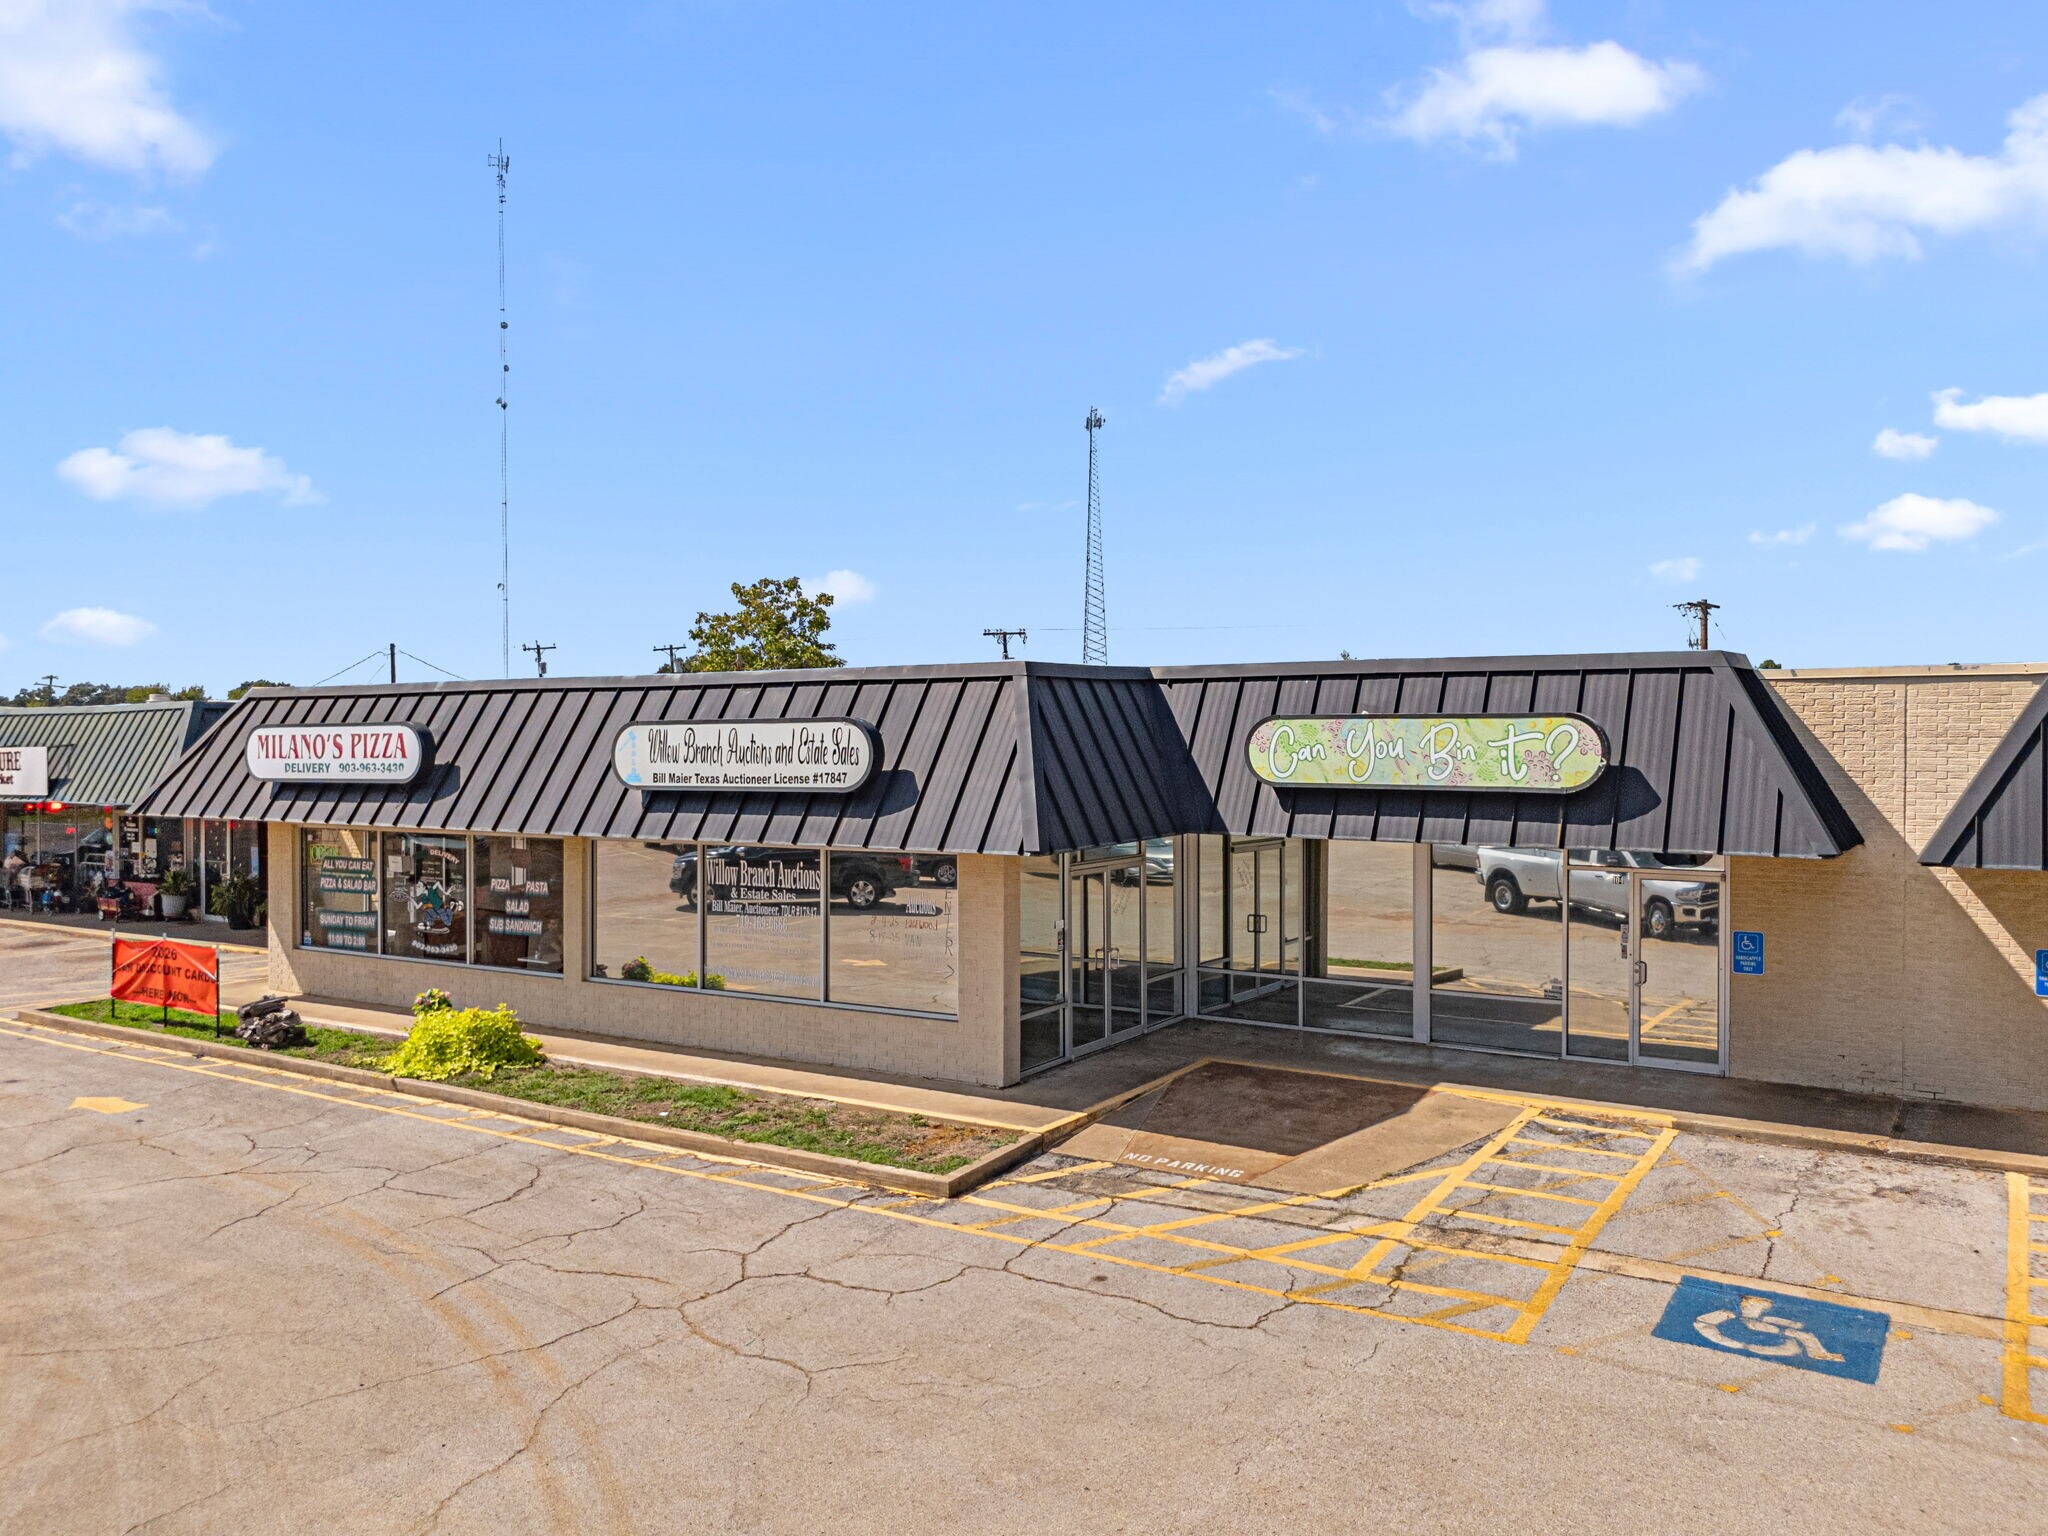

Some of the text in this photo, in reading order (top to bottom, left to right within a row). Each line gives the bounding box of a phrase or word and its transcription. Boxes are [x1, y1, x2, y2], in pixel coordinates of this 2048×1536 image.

[257, 733, 408, 760] MILANO'S PIZZA
[648, 727, 860, 767] Willow Branch Auctions and Estate Sales
[1269, 725, 1326, 778] Can
[1346, 721, 1404, 782] You
[1420, 722, 1476, 781] Bin
[284, 763, 404, 773] DELIVERY 903-963-3430
[652, 772, 848, 785] Bill Maier Texas Auctioneer License #17847
[429, 849, 460, 865] DELIVERY
[323, 860, 373, 871] ALL YOU CAN EAT
[706, 858, 821, 890] Willow Branch Auctions
[321, 878, 376, 891] PIZZA & SALAD BAR
[490, 879, 548, 893] PIZZA PASTA
[730, 887, 796, 901] & Estate Sales
[505, 900, 529, 912] SALAD
[712, 900, 723, 912] Bill
[320, 914, 376, 926] SUNDAY TO FRIDAY
[489, 918, 542, 932] SUB SANDWICH
[344, 935, 352, 945] TO
[1123, 1152, 1245, 1178] NO PARKING
